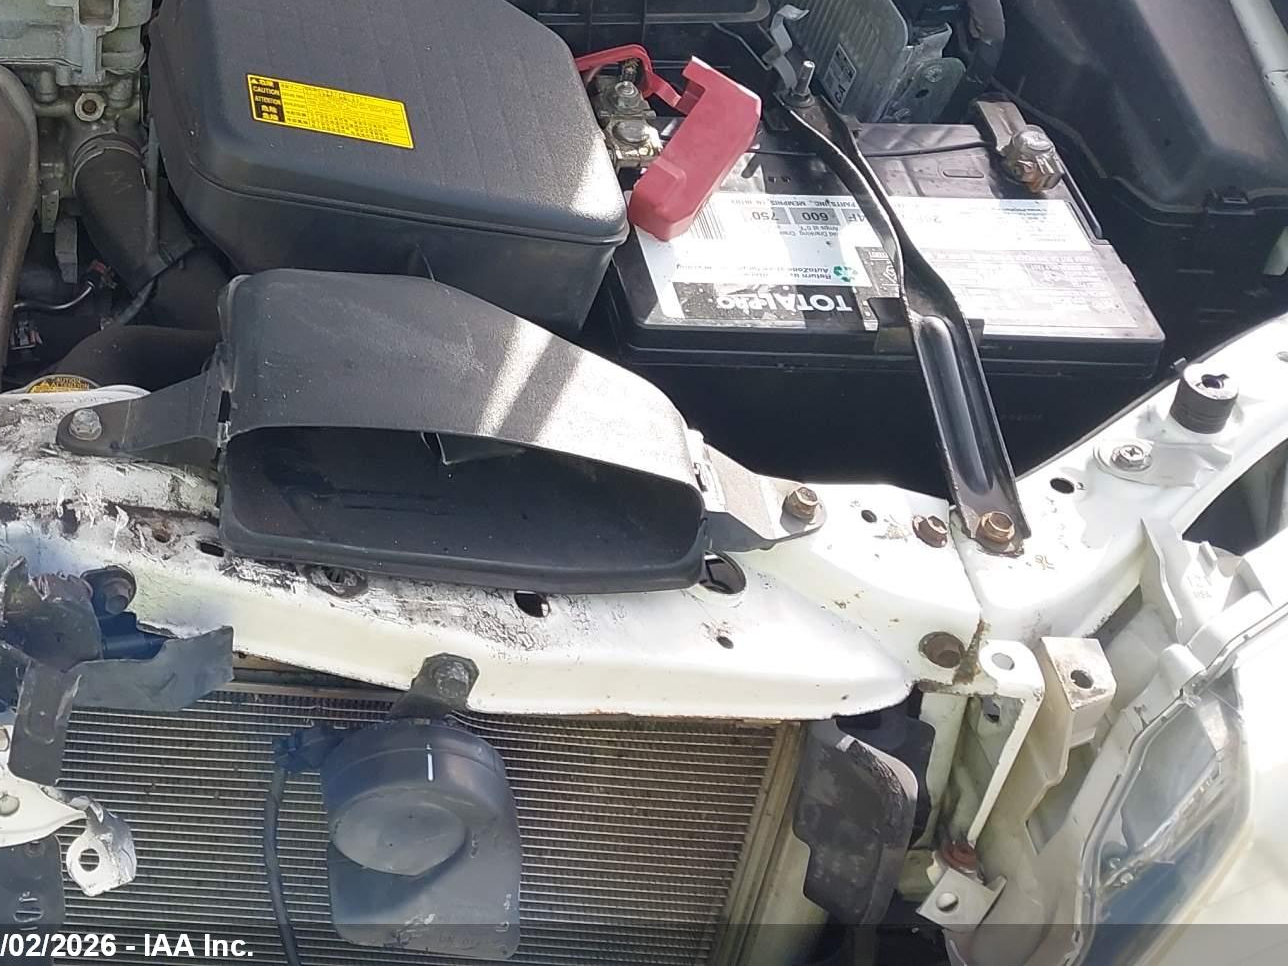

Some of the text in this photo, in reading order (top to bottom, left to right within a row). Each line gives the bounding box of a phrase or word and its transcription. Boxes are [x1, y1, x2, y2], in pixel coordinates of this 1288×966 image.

[253, 85, 280, 97] CAUTION
[254, 95, 281, 106] ATTENTION
[751, 212, 779, 221] 750
[801, 212, 829, 221] 600
[801, 272, 832, 280] Return
